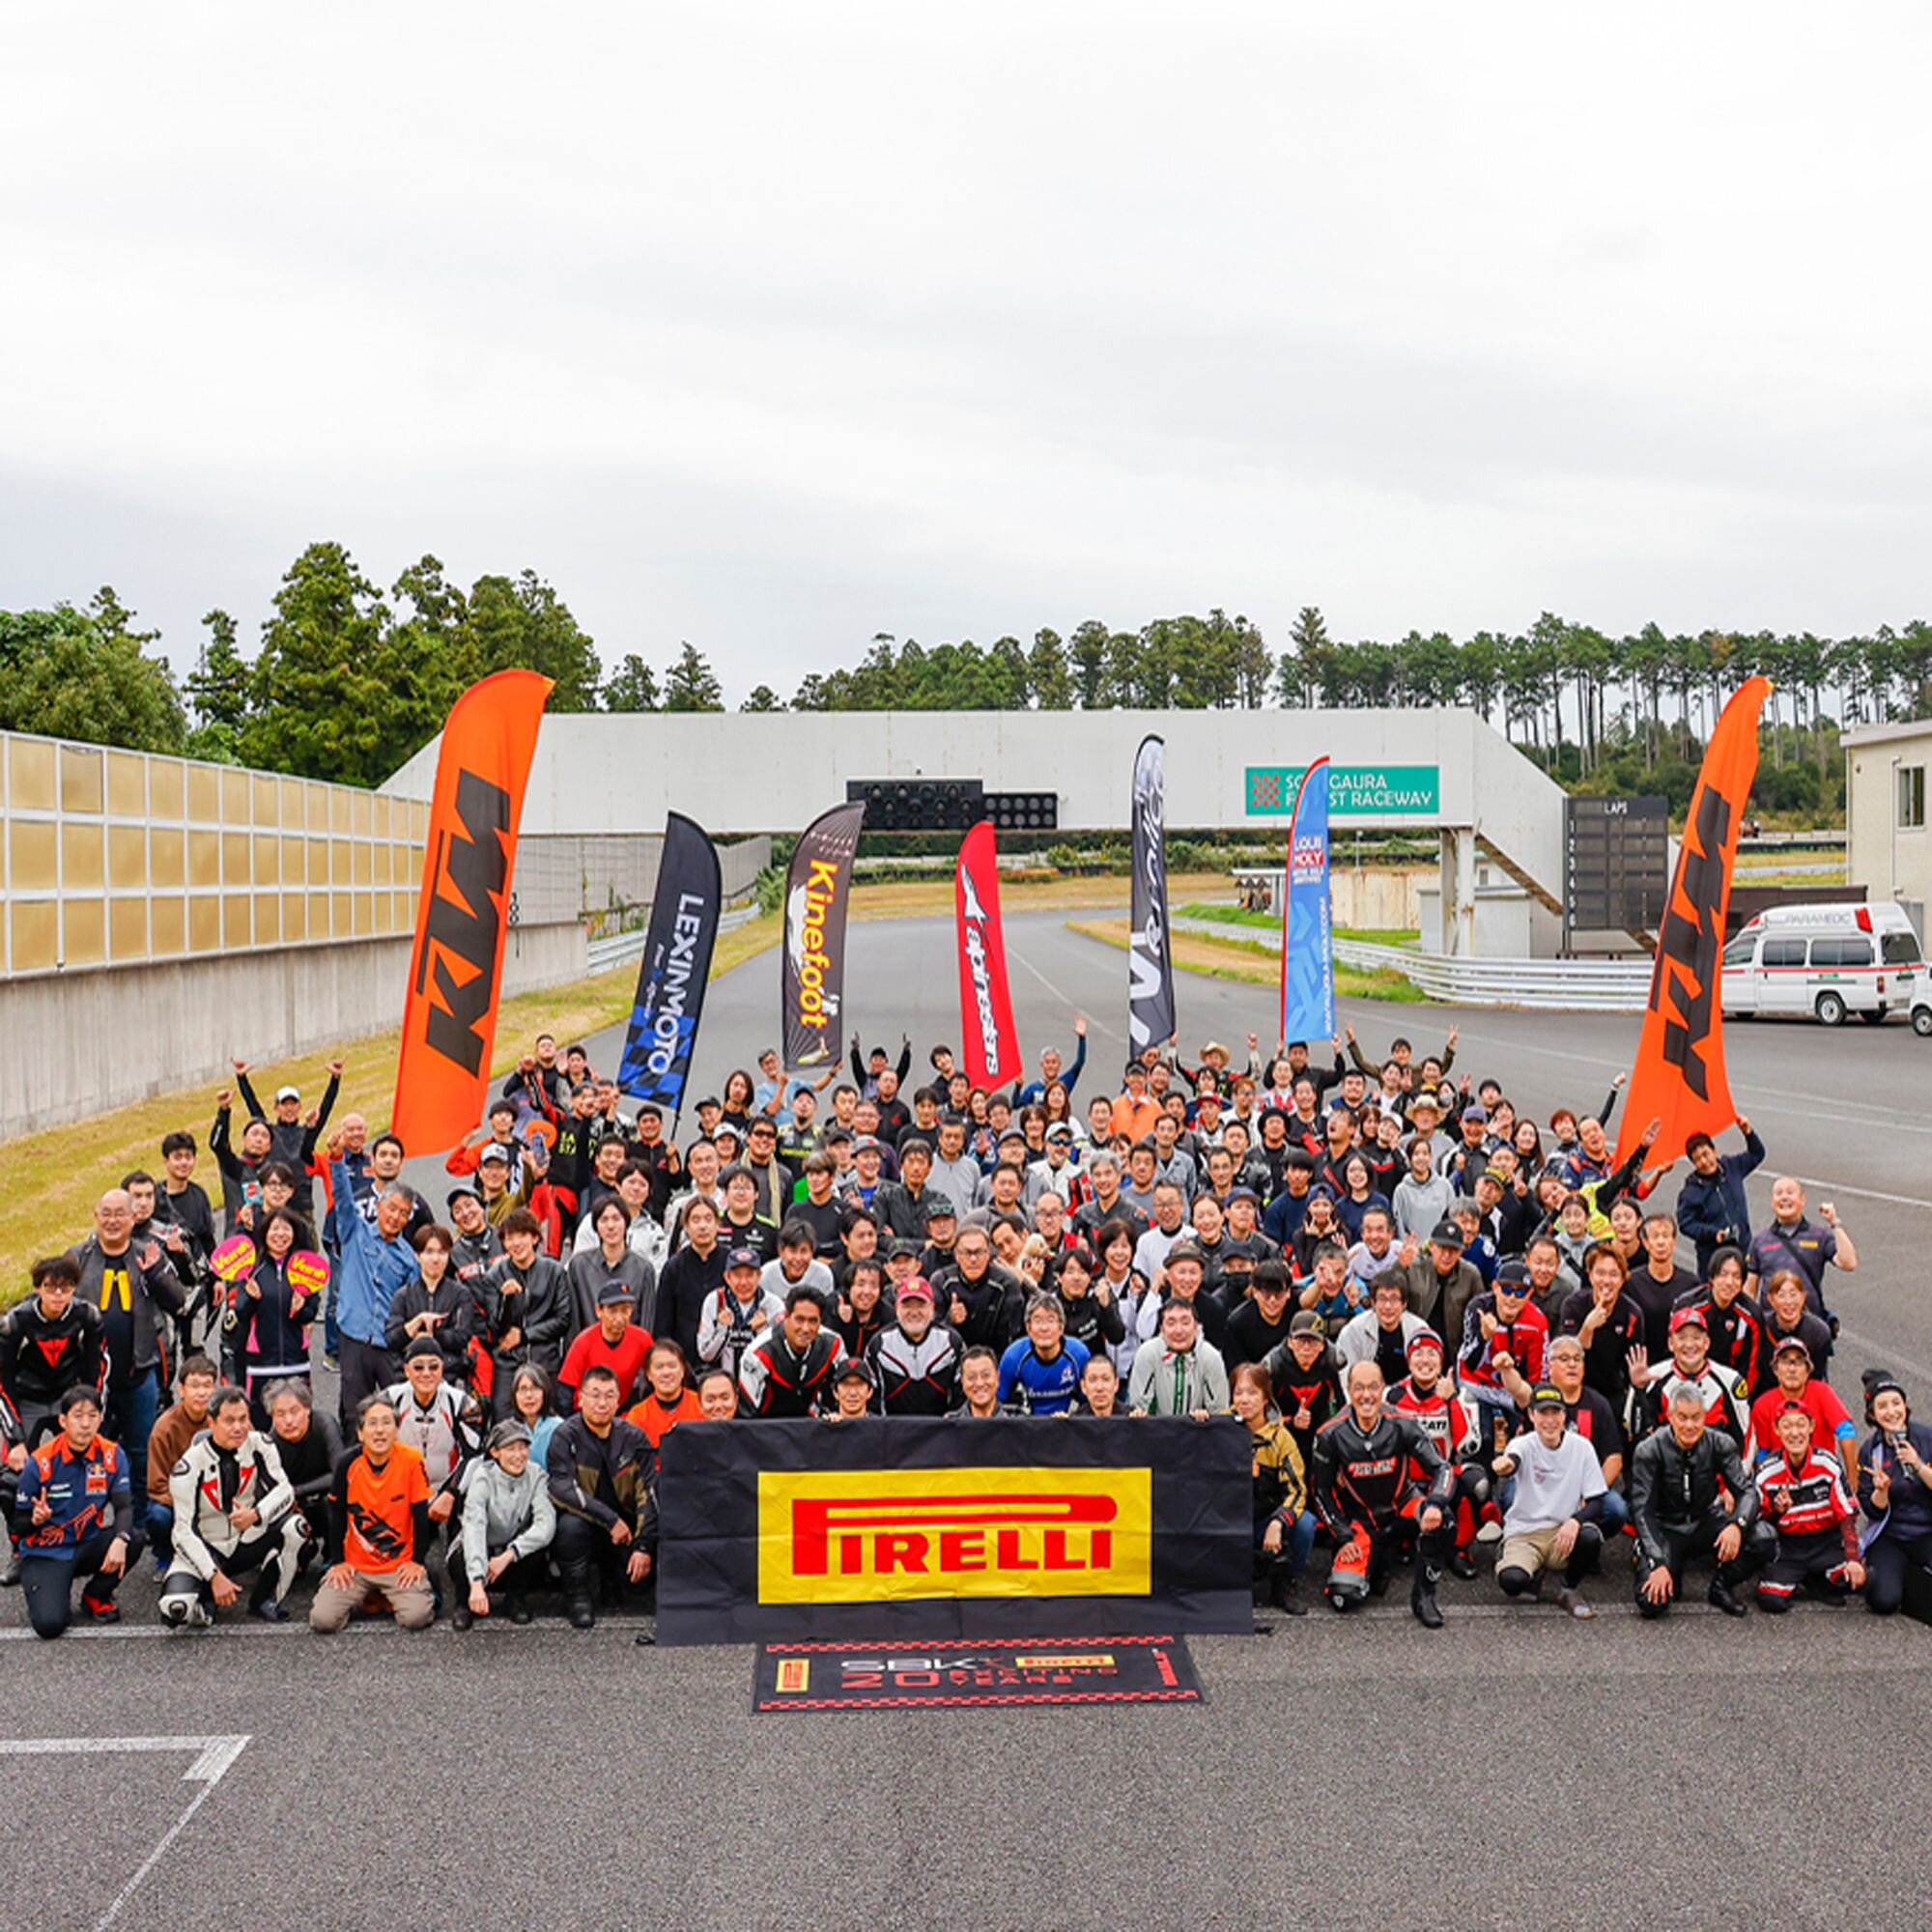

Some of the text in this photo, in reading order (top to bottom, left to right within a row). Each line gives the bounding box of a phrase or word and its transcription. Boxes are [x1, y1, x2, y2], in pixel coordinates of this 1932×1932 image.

[1286, 775, 1387, 789] SOGAURA
[1286, 790, 1433, 807] FST RACEWAY
[1605, 801, 1628, 814] LAPS
[1569, 838, 1576, 852] 2
[416, 767, 511, 1080] KTM
[799, 858, 838, 1029] Kinefoot
[1650, 782, 1731, 1103] KTM
[648, 893, 704, 1075] LEXINMOTO
[966, 923, 1000, 1076] alpinestars
[792, 1494, 1118, 1576] PIRELLI
[841, 1671, 941, 1689] 20
